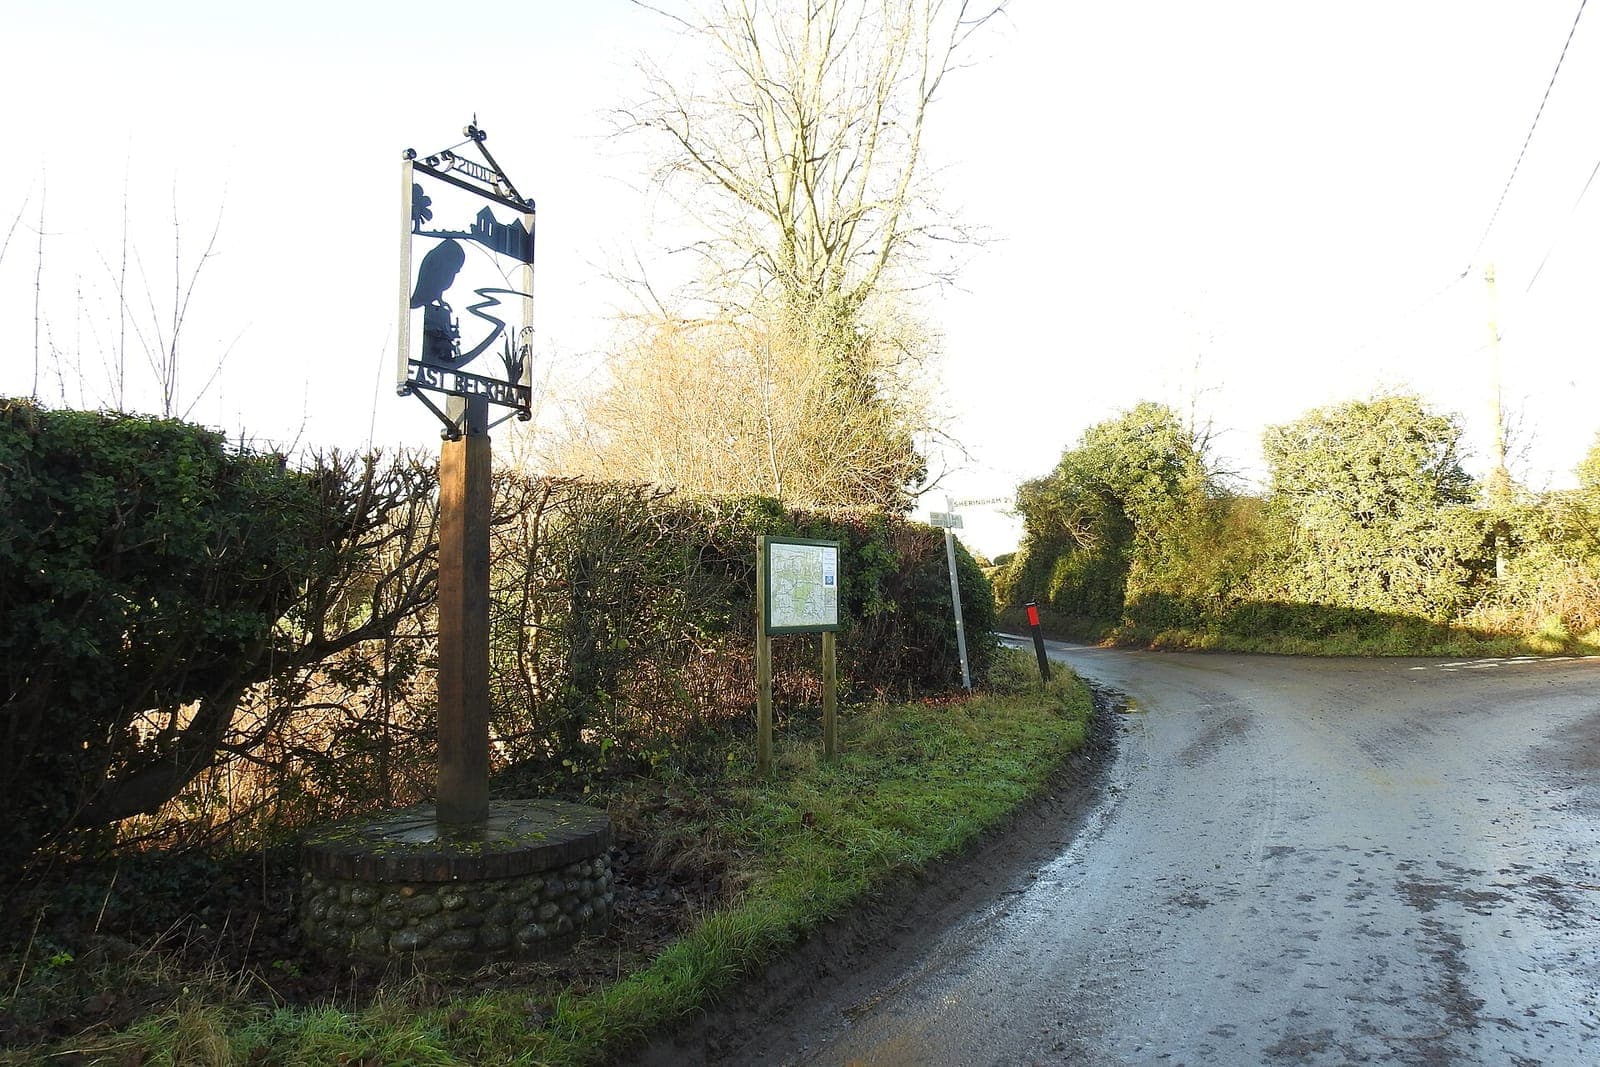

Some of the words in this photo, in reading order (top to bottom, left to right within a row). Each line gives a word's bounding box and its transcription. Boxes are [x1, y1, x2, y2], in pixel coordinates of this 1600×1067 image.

[457, 157, 491, 184] 2000
[408, 362, 447, 391] EAST
[456, 374, 531, 407] BECKHAM
[954, 498, 1002, 508] SHERINGHAM
